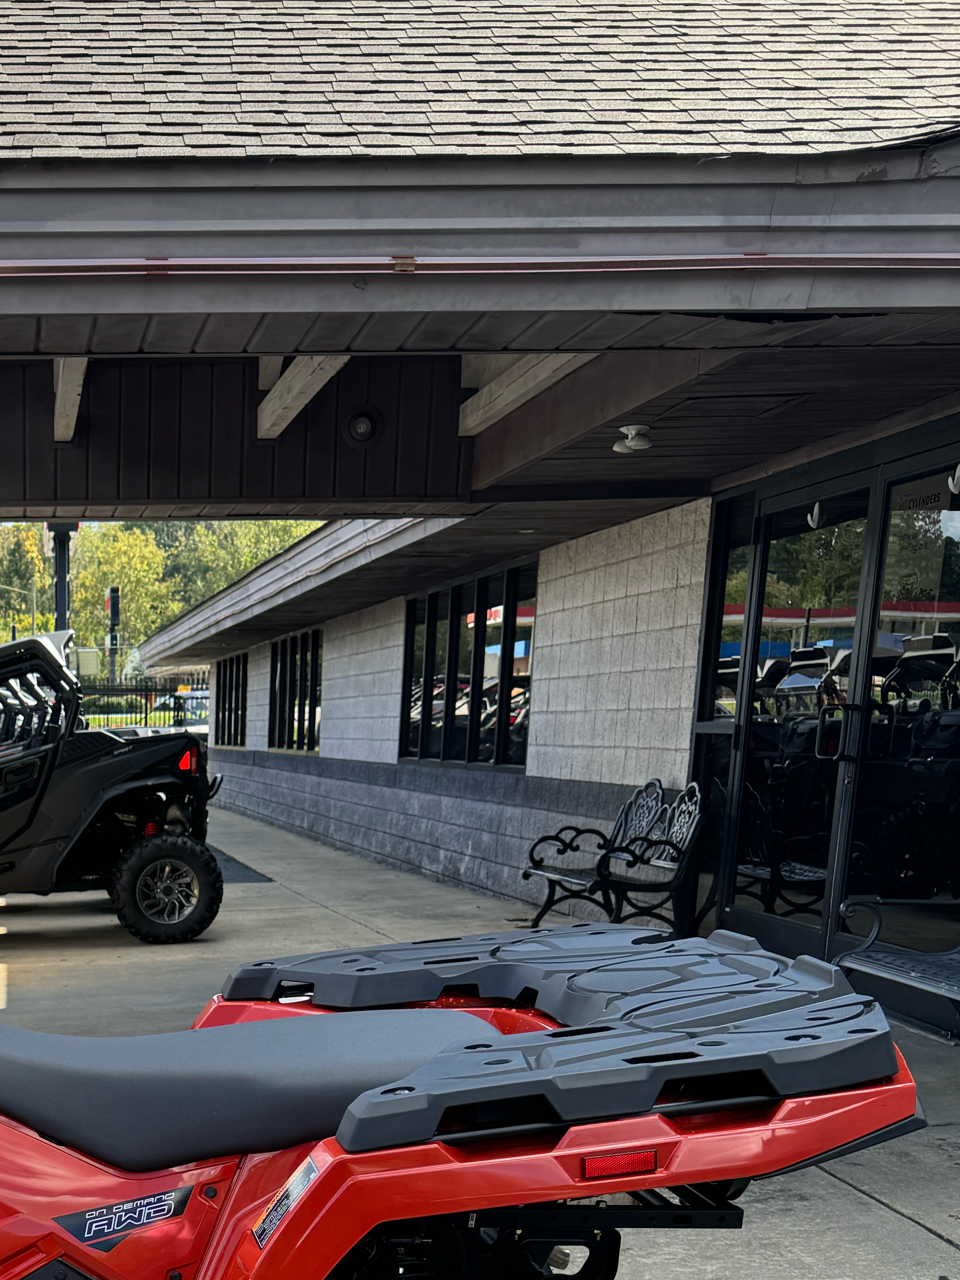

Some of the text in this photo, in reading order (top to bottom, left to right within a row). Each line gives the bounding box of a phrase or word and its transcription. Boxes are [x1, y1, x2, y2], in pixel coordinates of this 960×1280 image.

[84, 1200, 175, 1238] AWD
[85, 1192, 175, 1219] ON DEMAND
